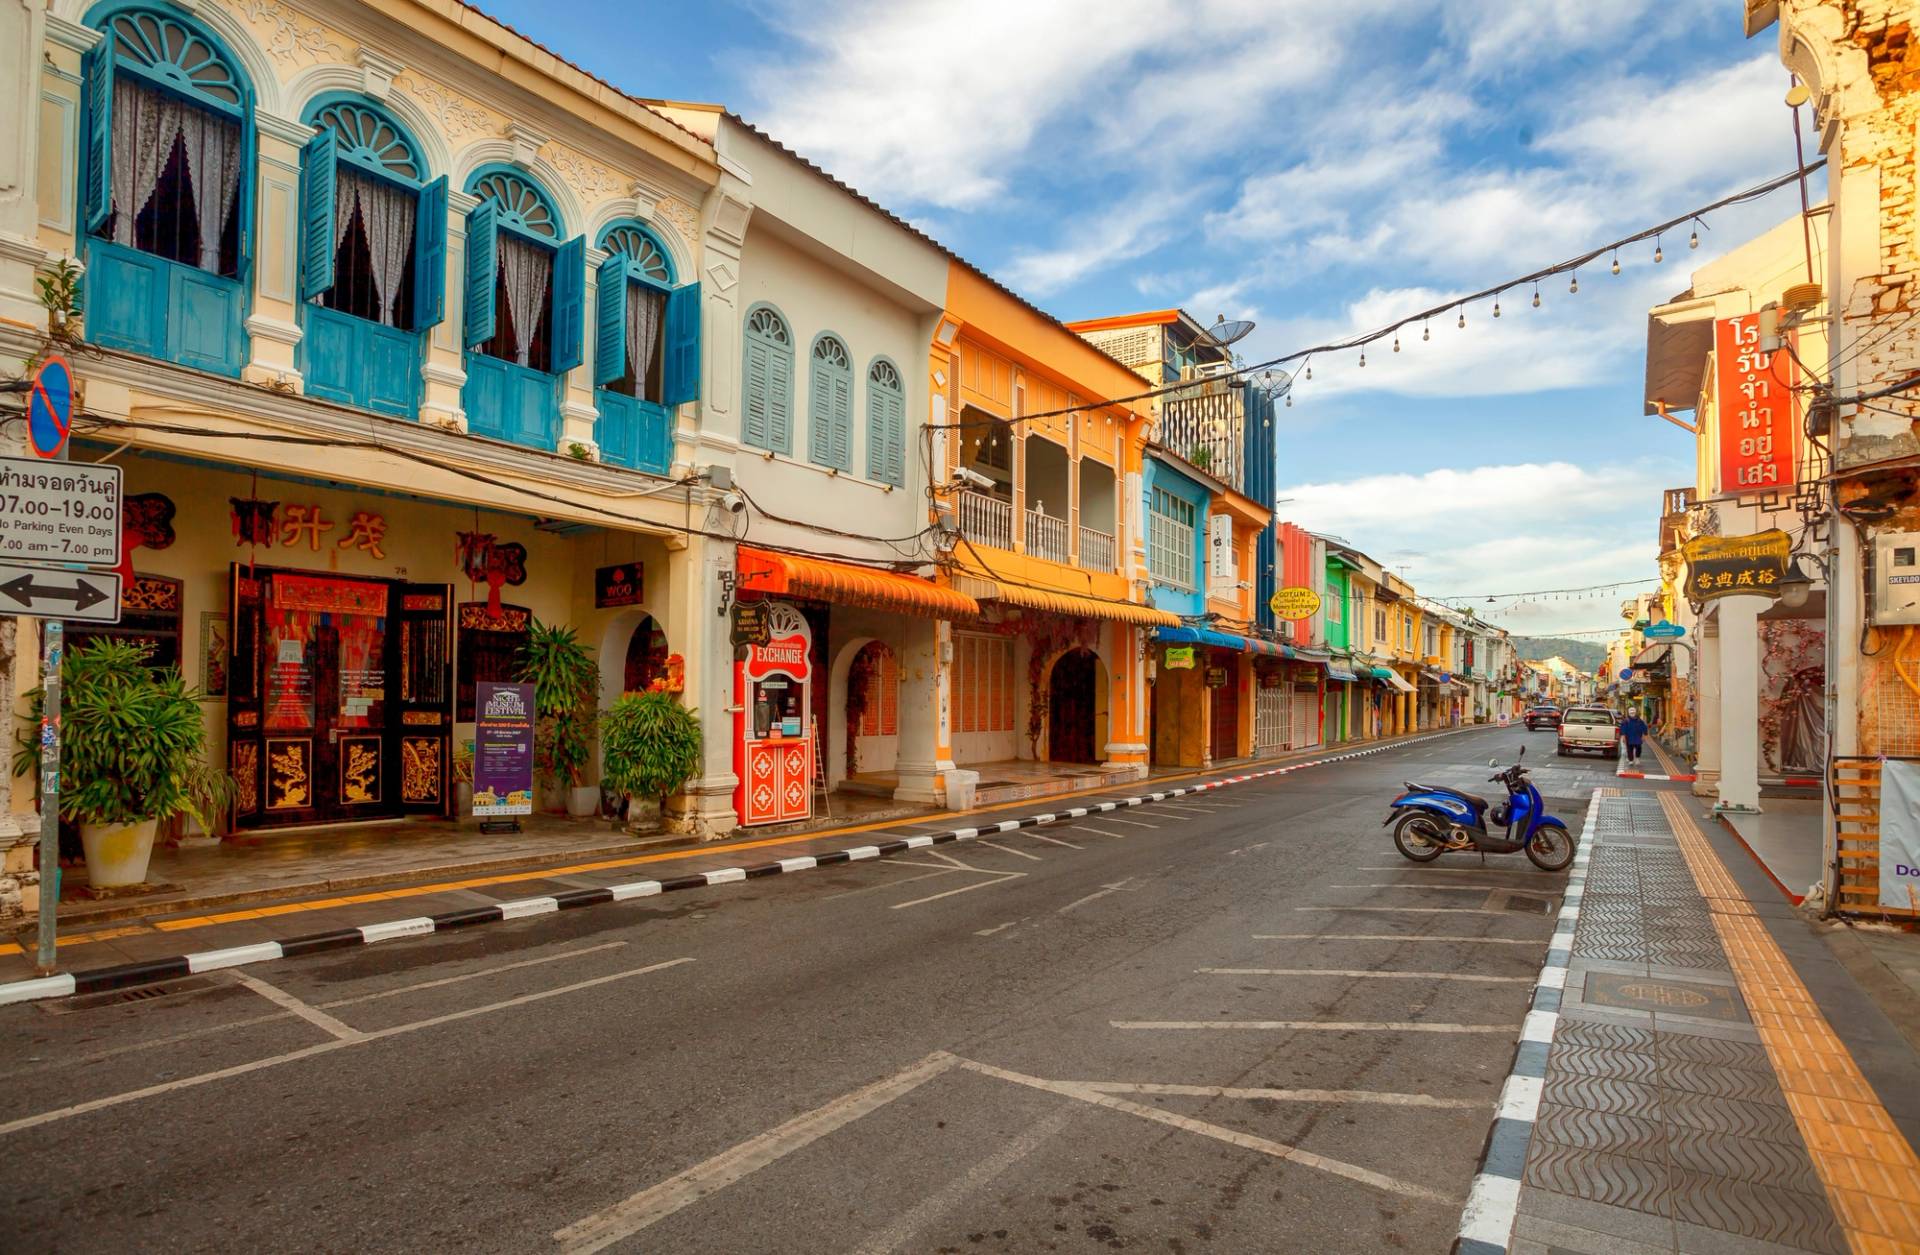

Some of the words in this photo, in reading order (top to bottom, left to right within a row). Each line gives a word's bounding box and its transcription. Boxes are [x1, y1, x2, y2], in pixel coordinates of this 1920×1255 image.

[14, 520, 54, 534] Parking
[58, 523, 83, 534] Even
[88, 526, 113, 537] Days
[28, 542, 47, 551] am
[61, 539, 88, 554] 7.00
[93, 547, 113, 556] pm
[607, 584, 631, 597] WOO
[757, 647, 802, 664] EXCHANGE
[1896, 865, 1920, 877] Do
